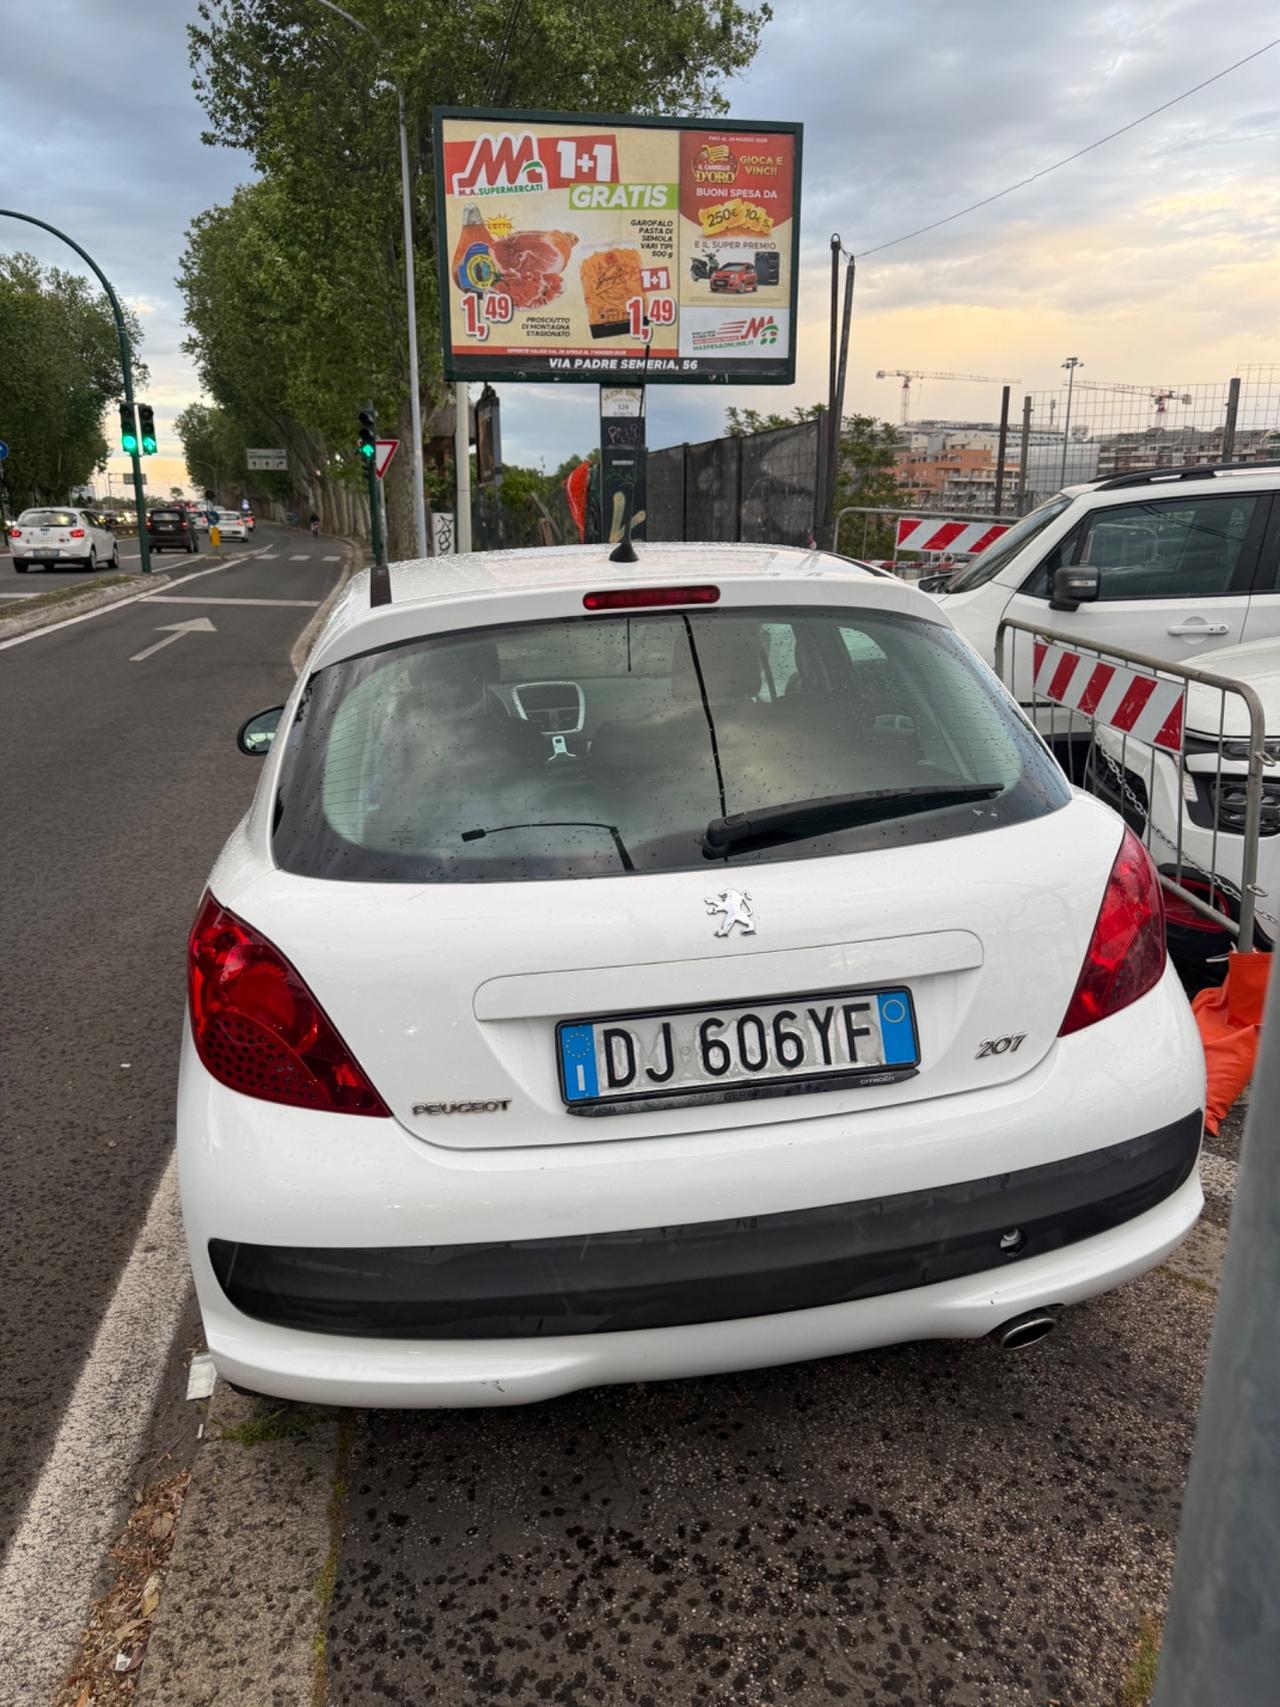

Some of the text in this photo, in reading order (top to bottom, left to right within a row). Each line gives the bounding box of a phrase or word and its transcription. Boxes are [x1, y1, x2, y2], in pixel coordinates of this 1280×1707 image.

[557, 140, 612, 182] 1+1
[739, 155, 784, 166] GIOCA E
[695, 171, 736, 184] D'ORO
[571, 185, 669, 208] GRATIS
[696, 187, 778, 199] BUONI SPESA DA
[631, 219, 673, 227] GAROFALO
[708, 208, 738, 227] 250€
[641, 235, 673, 243] SEMOLA
[694, 241, 777, 250] E IL SUPER PREMIO
[640, 270, 667, 288] 1+1
[549, 358, 698, 371] VIA PADRE SEMERIA, 56
[603, 1022, 675, 1088] DJ
[698, 1002, 871, 1077] 606YF
[975, 1031, 1028, 1059] 207
[411, 1098, 512, 1115] PEUGEOT
